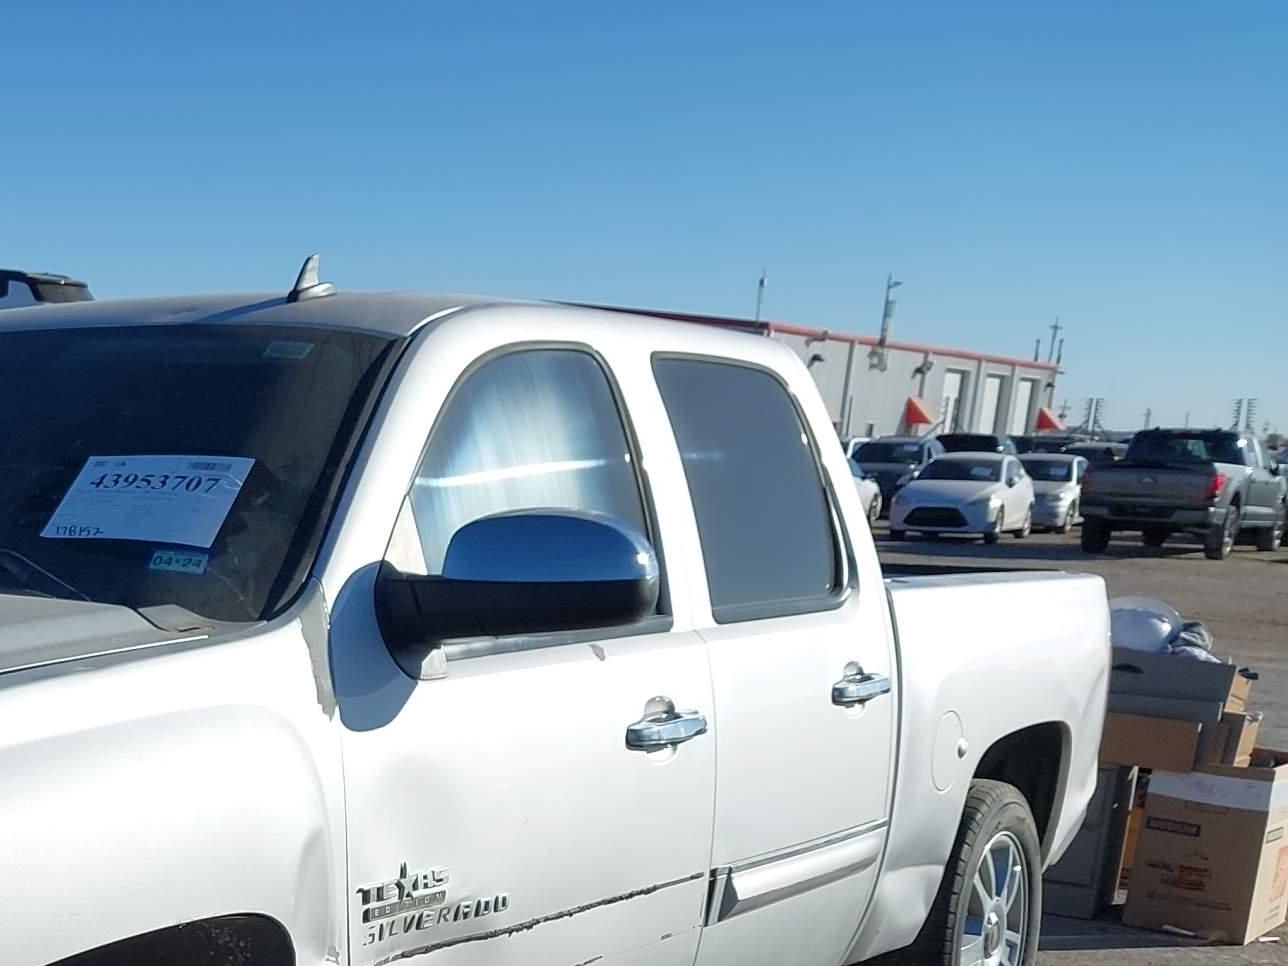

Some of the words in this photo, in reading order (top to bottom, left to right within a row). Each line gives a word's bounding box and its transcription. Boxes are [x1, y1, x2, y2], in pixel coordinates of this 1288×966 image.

[89, 472, 221, 494] 43953707
[355, 861, 450, 905] TEXAS
[362, 893, 510, 946] SILVERADO
[372, 891, 444, 917] EDITION
